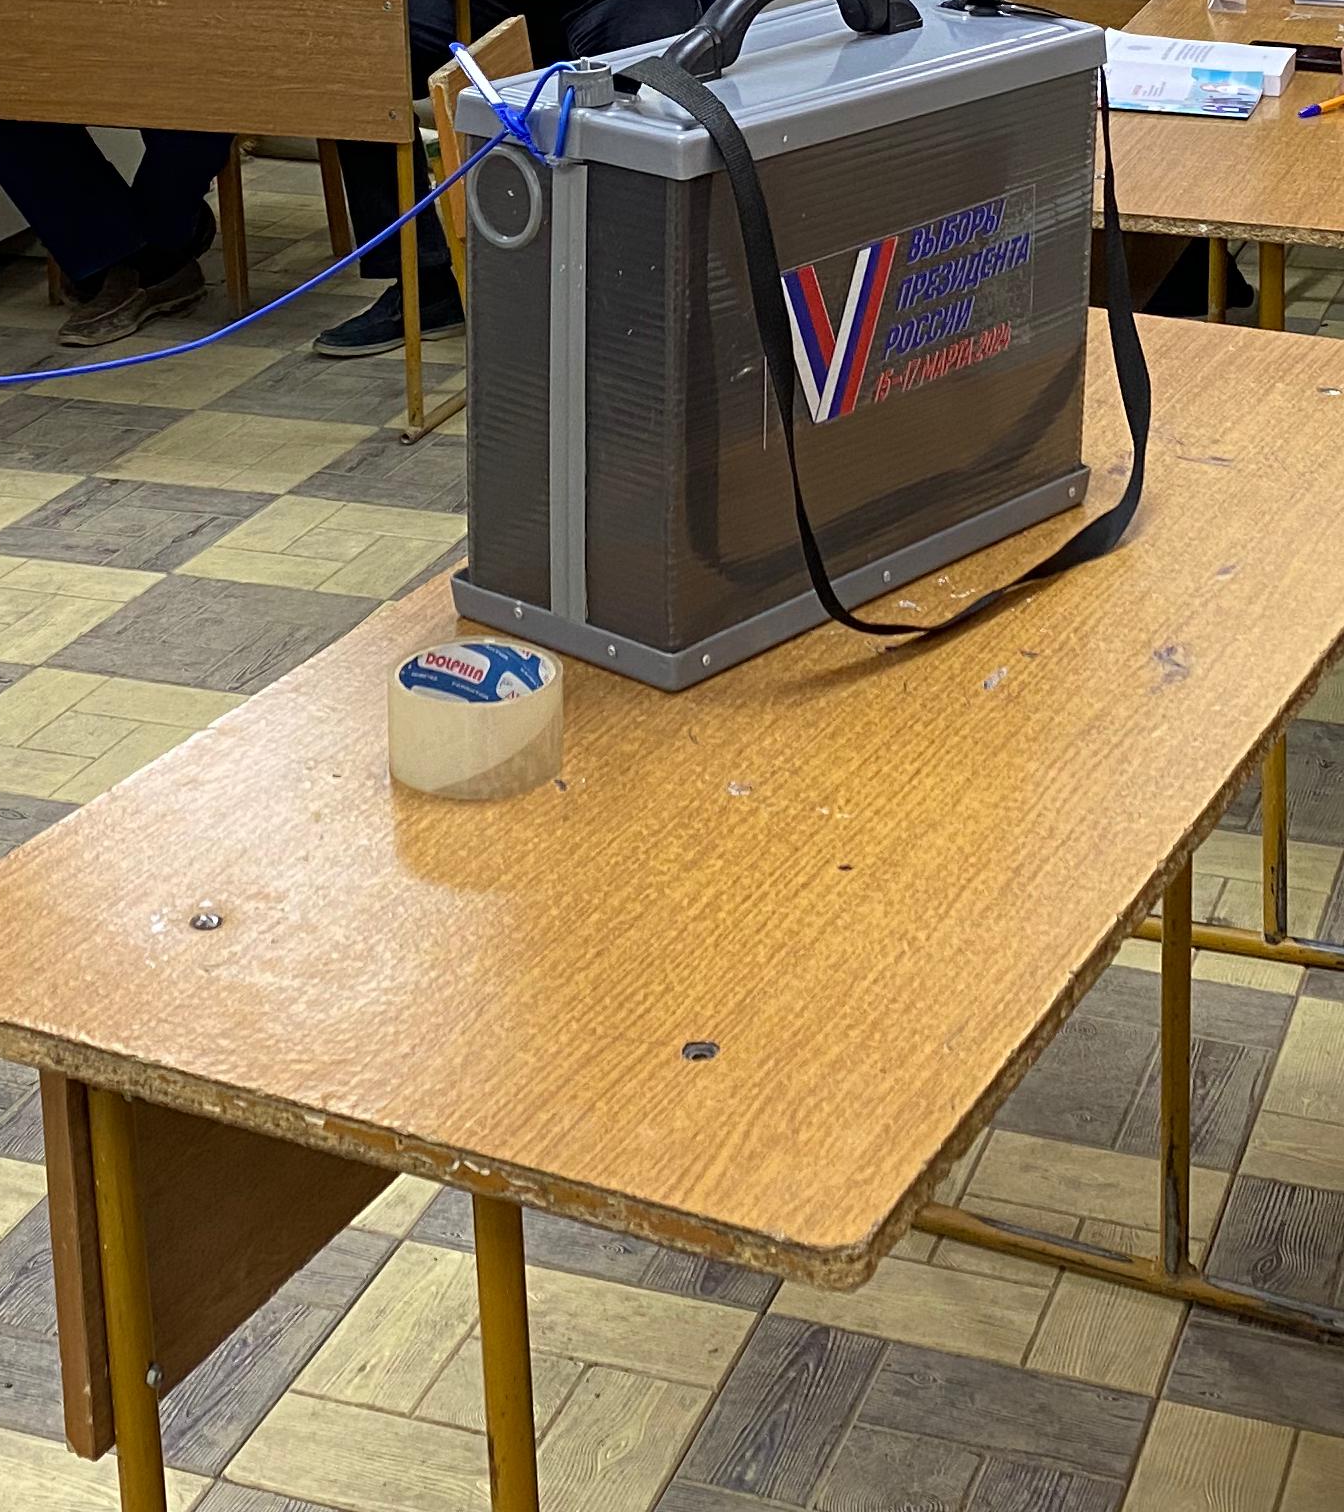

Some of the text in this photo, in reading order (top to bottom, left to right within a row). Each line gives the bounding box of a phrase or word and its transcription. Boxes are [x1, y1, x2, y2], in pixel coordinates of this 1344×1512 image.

[907, 198, 1006, 266] ВЫБОРЫ
[895, 232, 1034, 312] ПРЕЗИДЕНТА
[882, 295, 976, 361] РОССИИ
[918, 336, 975, 387] МАРТА
[975, 320, 1012, 362] 2024
